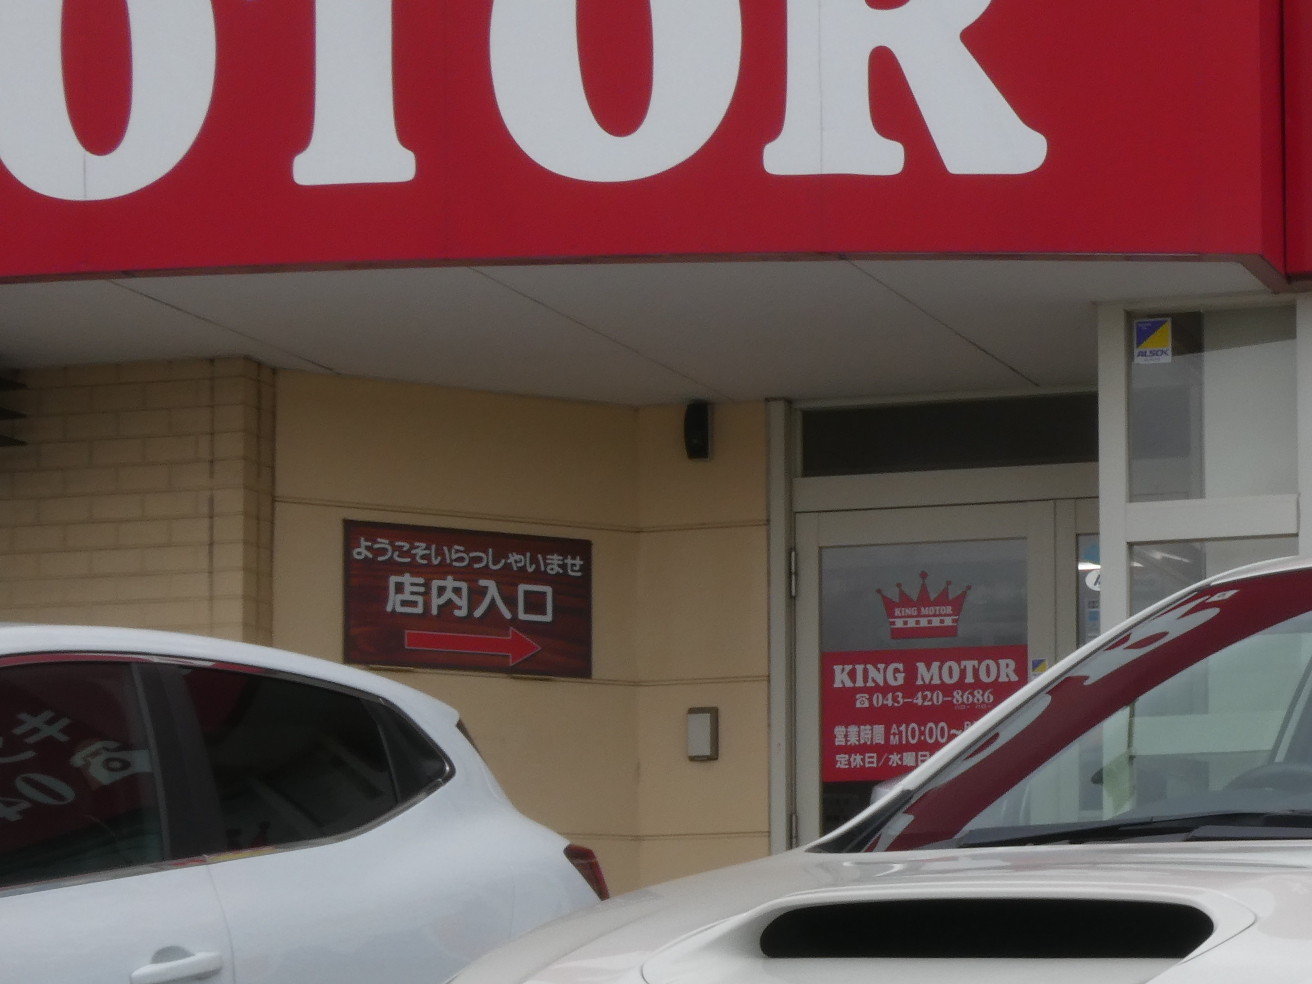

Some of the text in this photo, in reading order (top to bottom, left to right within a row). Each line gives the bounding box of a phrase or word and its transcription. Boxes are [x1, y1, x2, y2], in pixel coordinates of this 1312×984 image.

[1136, 349, 1169, 358] ALSOK
[385, 572, 554, 623] 店内入口
[894, 605, 953, 617] KING MOTOR
[832, 658, 1019, 688] KING MOTOR
[872, 688, 994, 707] 043-420-8686
[833, 724, 885, 746] 営業時間
